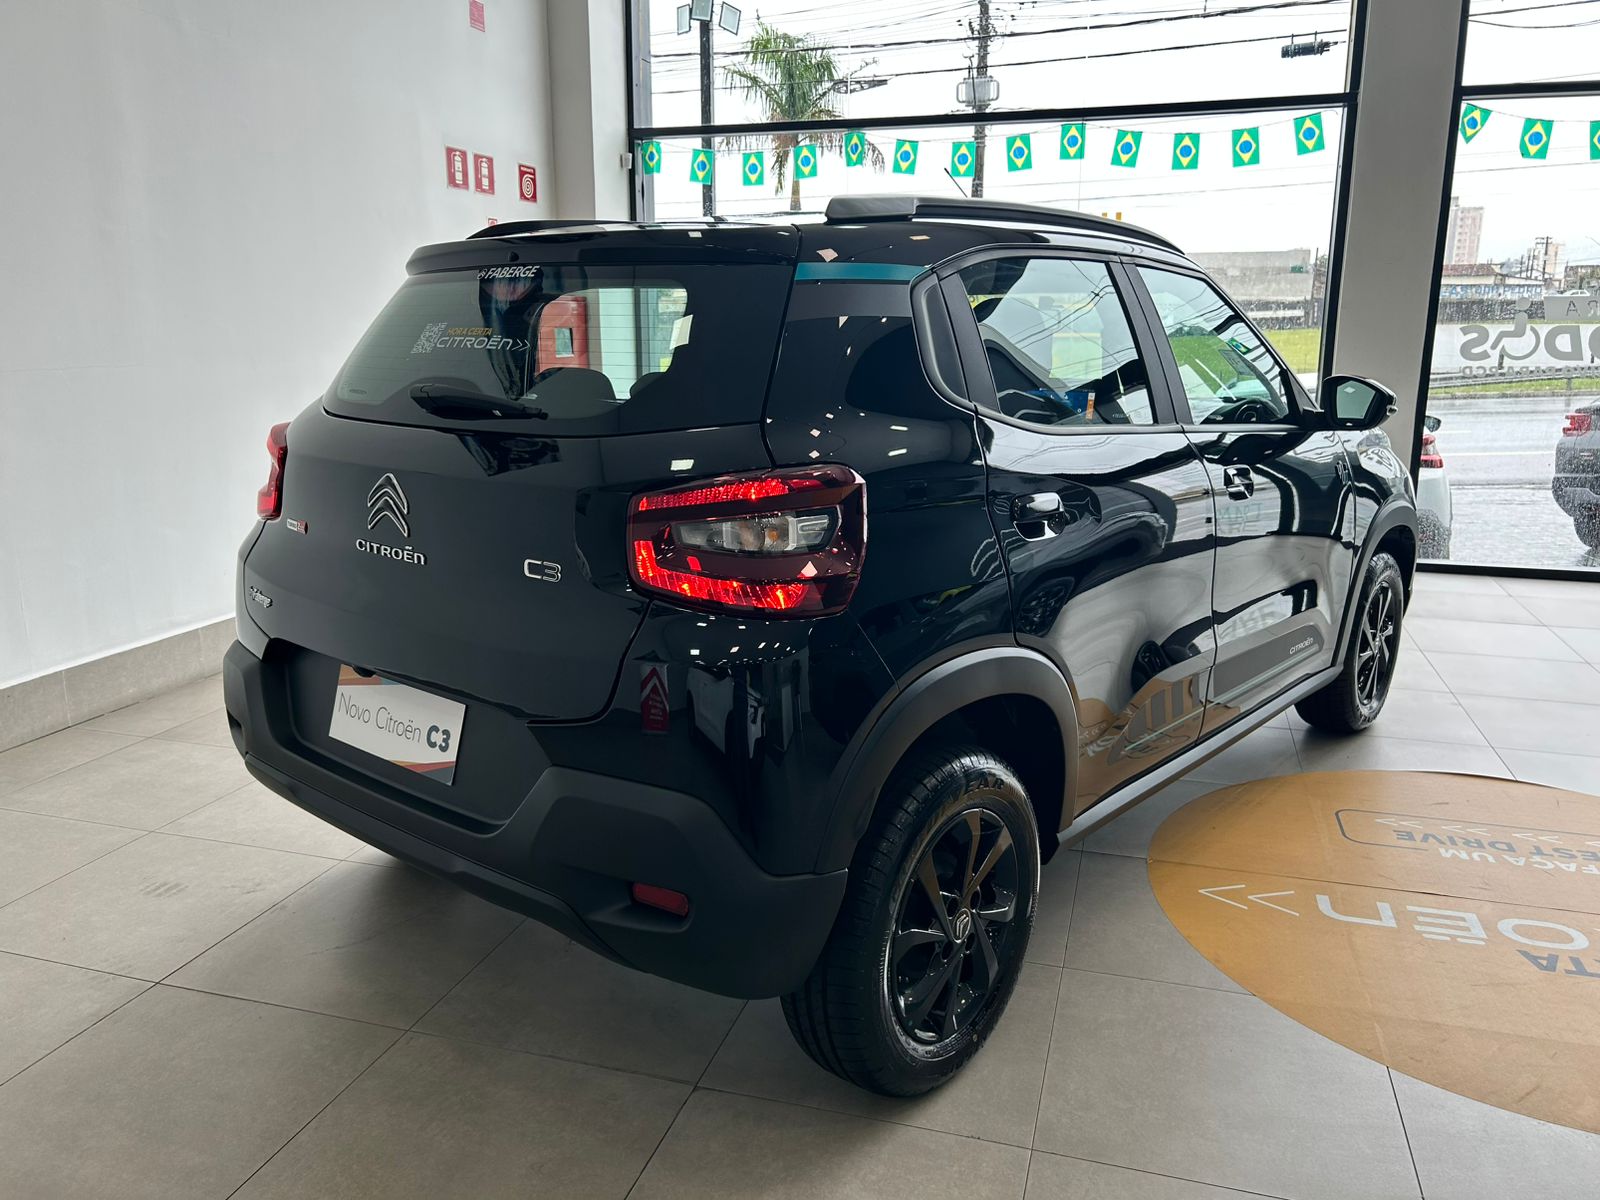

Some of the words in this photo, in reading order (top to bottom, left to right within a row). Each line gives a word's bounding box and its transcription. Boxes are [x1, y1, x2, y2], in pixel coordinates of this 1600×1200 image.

[485, 265, 540, 279] FABERGE
[523, 558, 562, 583] C3
[338, 691, 371, 724] Novo
[375, 706, 421, 743] Citroën
[426, 724, 451, 753] C3
[1392, 829, 1517, 853] DRIVE
[1437, 847, 1496, 864] UM
